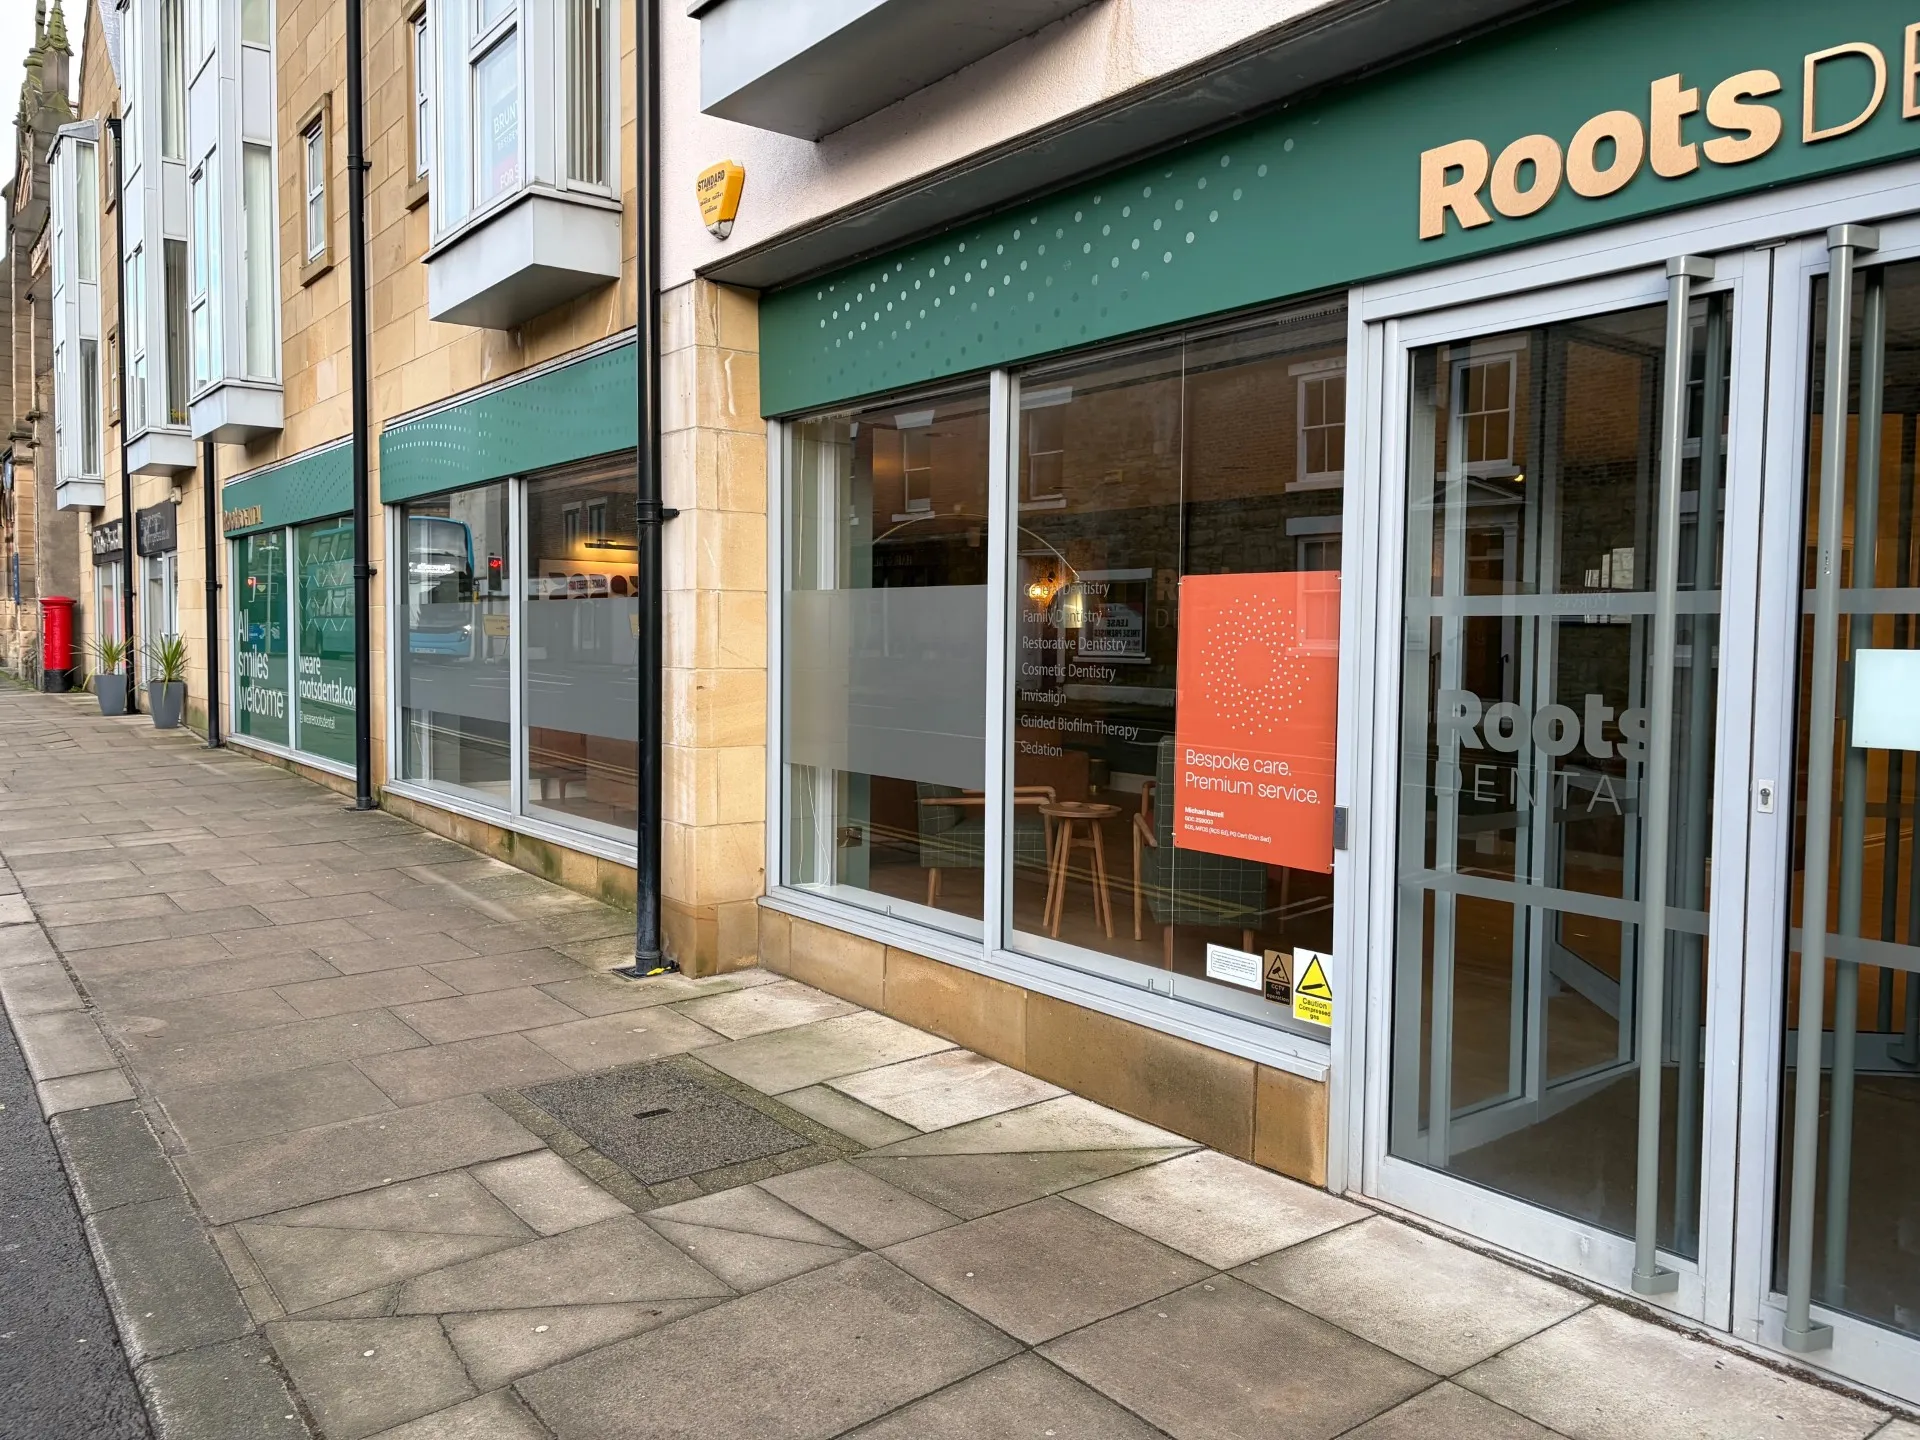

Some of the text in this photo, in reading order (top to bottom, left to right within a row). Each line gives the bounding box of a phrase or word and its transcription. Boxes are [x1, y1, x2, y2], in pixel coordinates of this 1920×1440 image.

[1419, 69, 1783, 241] Roots
[697, 169, 725, 192] STANDARD
[1023, 582, 1110, 597] Genel Dentistry
[238, 608, 249, 642] All
[1023, 609, 1053, 625] Family
[1022, 636, 1076, 649] Restorative
[1078, 637, 1127, 654] Dentistry
[238, 644, 269, 679] smiles
[1021, 662, 1116, 683] Cosmetic Dentistry
[238, 679, 284, 719] welcome
[1021, 688, 1067, 707] Invisalign
[1020, 714, 1139, 741] Guided Biofilm Therapy
[1436, 689, 1650, 763] Roots
[1020, 740, 1063, 757] Sedation
[1186, 748, 1292, 777] Bespoke care.
[1185, 771, 1321, 805] Premium service.
[1184, 806, 1206, 816] Michael
[1298, 1004, 1331, 1017] Compressed
[1302, 997, 1328, 1010] Caution
[1309, 1013, 1320, 1021] gas
